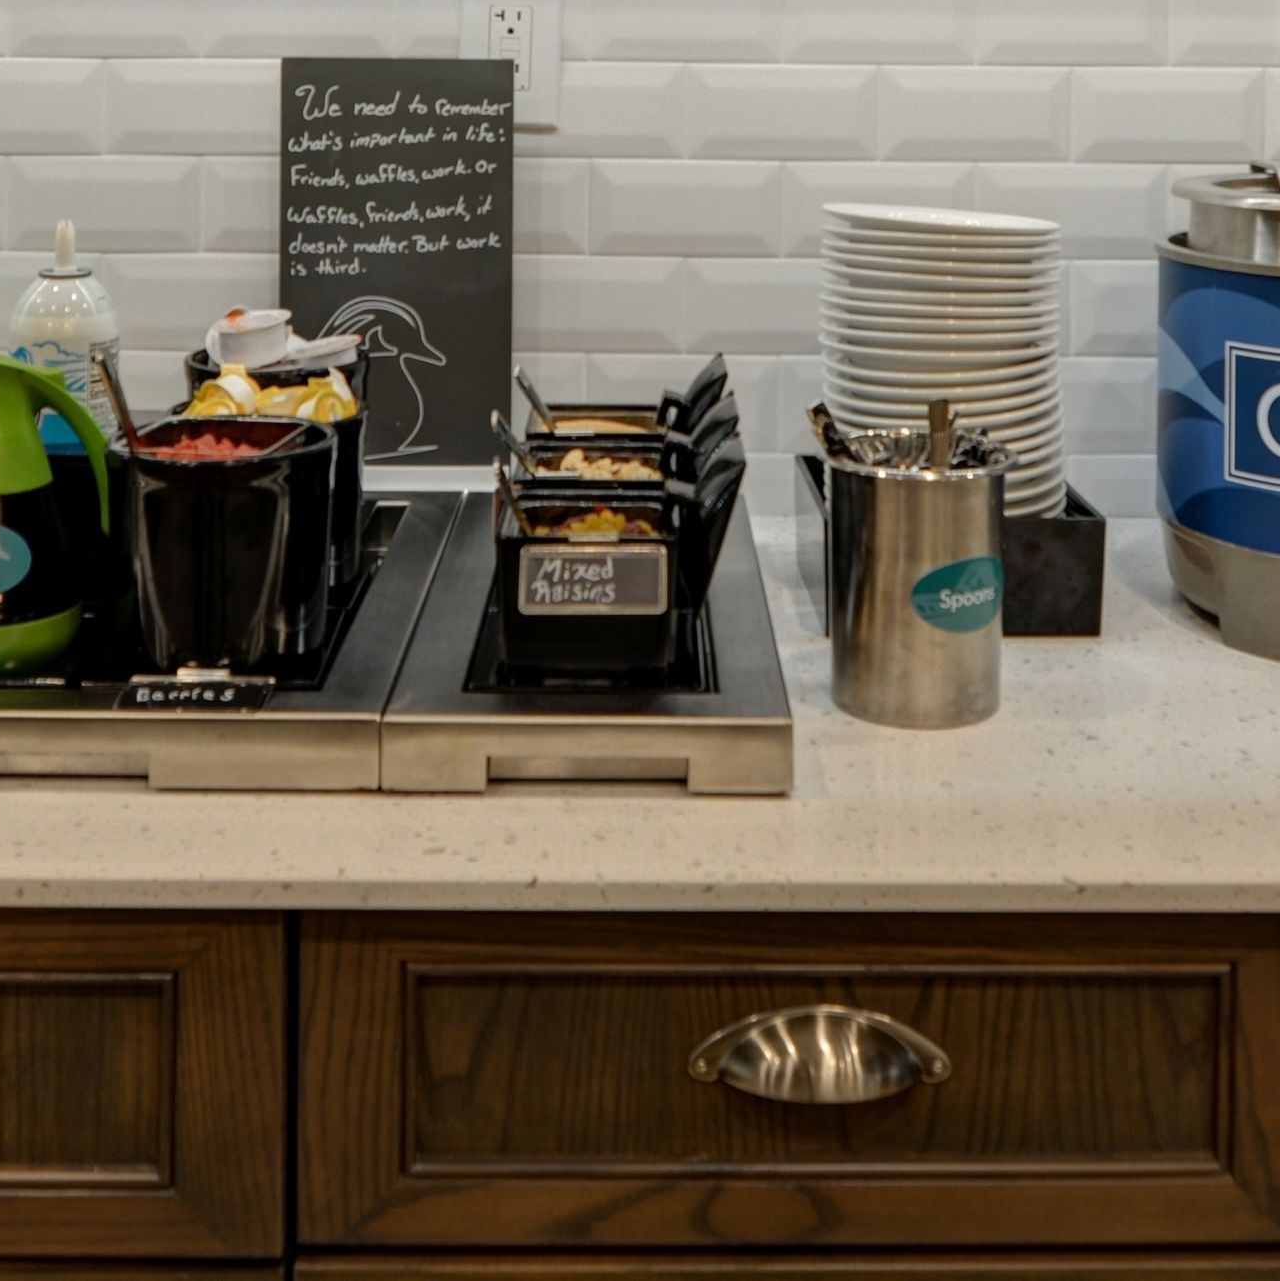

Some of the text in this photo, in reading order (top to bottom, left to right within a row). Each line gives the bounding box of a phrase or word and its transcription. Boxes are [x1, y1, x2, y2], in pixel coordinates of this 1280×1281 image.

[295, 84, 512, 120] We need to remember
[350, 126, 436, 149] important
[442, 126, 458, 141] in
[465, 122, 506, 143] life:
[291, 158, 498, 190] Friends, waffles, work. Or
[425, 195, 472, 222] work,
[476, 194, 492, 215] it
[288, 231, 502, 255] doesn't matter. But work
[290, 257, 367, 277] is third.
[536, 556, 614, 582] Mixed
[531, 579, 616, 604] Raisins
[939, 587, 996, 613] Spoons
